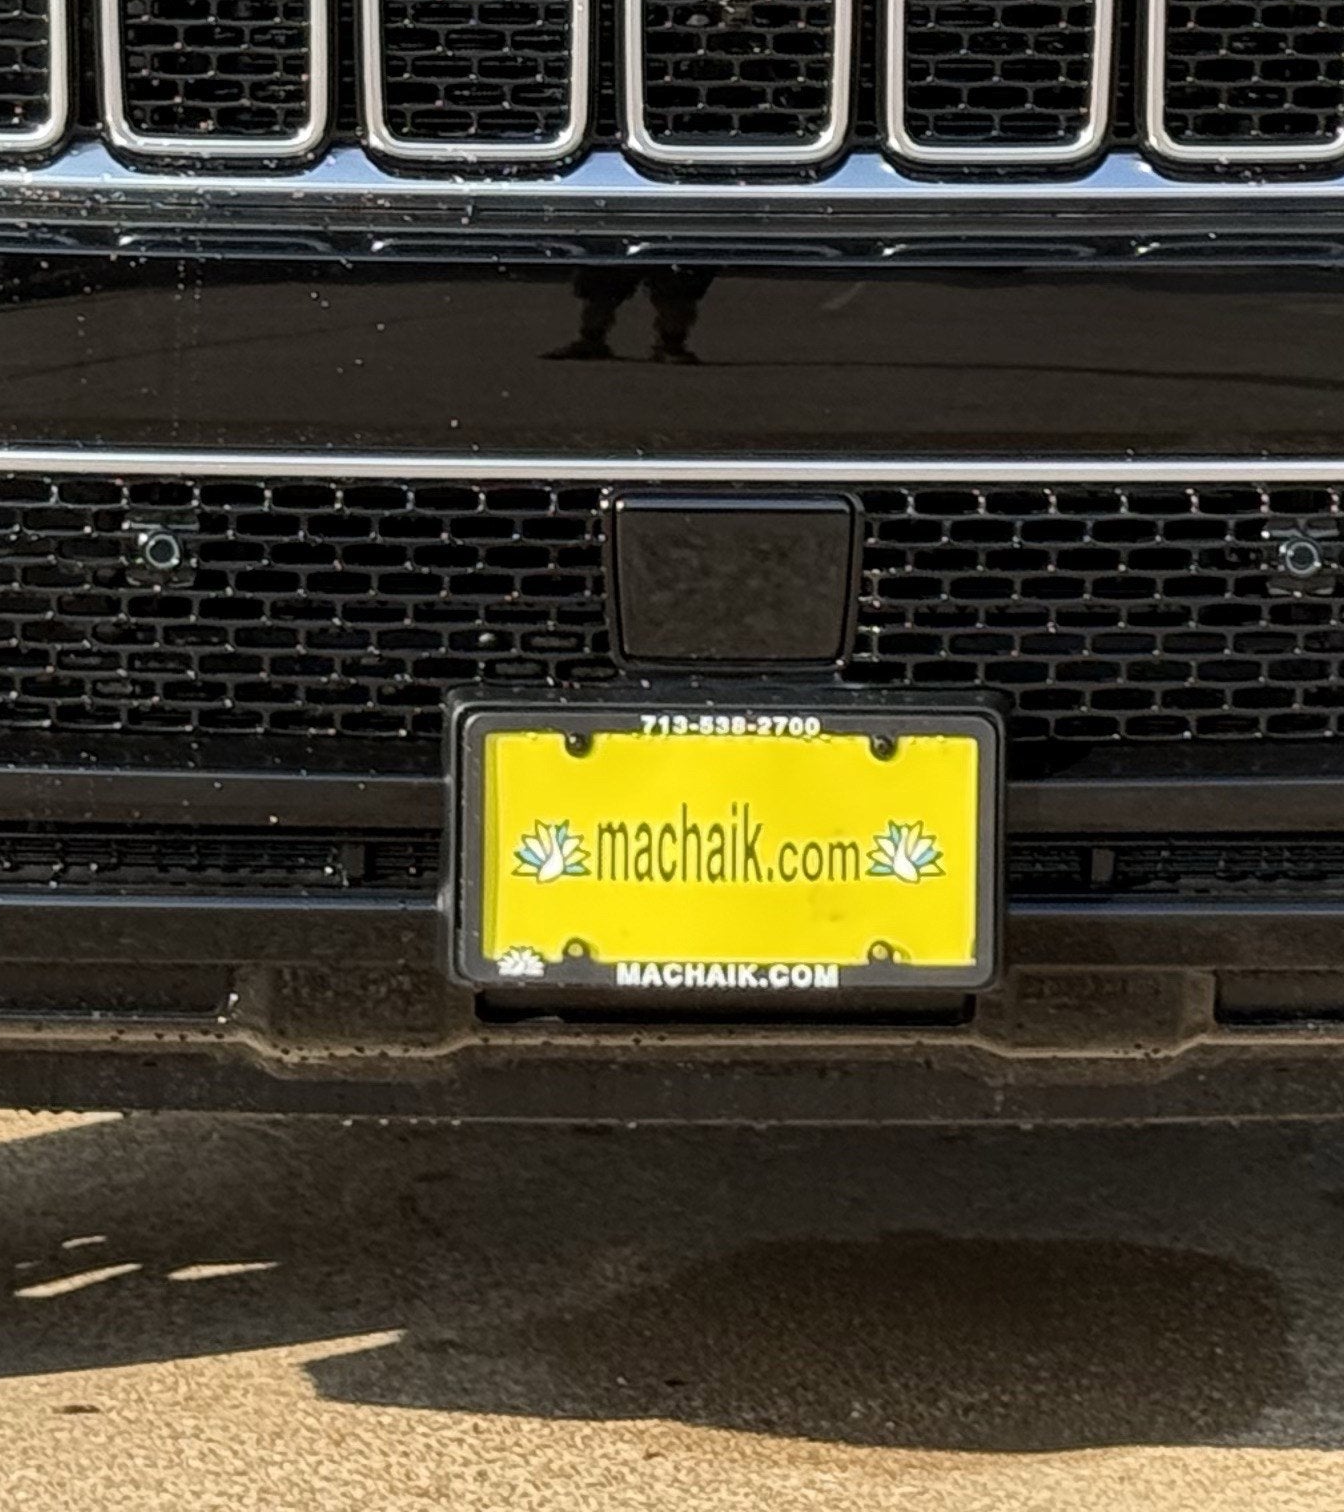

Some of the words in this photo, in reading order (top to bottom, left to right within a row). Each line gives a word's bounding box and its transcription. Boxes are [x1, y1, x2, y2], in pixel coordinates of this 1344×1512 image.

[639, 714, 822, 737] 713-538-2700
[596, 801, 862, 883] machaik.com
[615, 961, 840, 988] MACHAIK.COM
